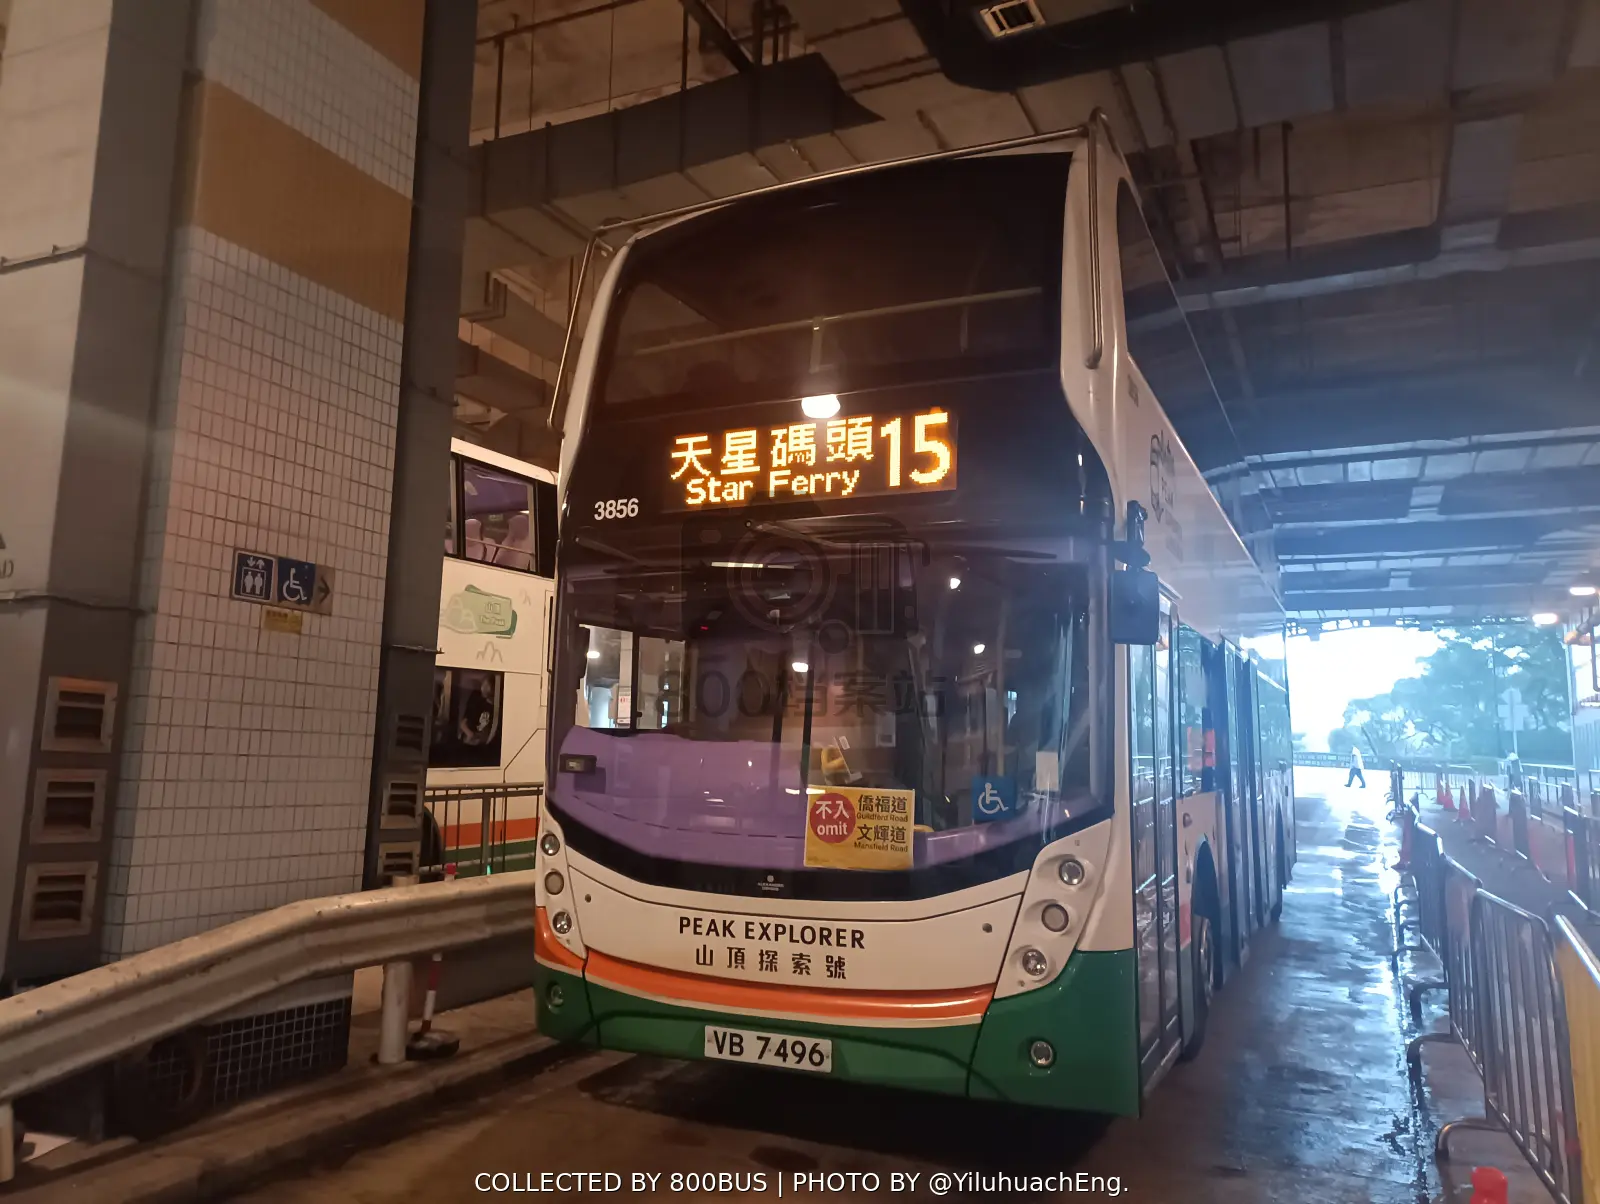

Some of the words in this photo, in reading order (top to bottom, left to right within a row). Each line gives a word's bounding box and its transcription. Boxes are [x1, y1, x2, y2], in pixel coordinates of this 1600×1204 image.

[670, 416, 875, 480] 天星碼頭
[880, 411, 951, 487] 15
[685, 477, 754, 505] Star
[768, 469, 861, 498] Ferry
[594, 497, 639, 521] 3856
[815, 800, 850, 820] 不入
[857, 794, 908, 814] 僑福道
[816, 821, 848, 836] omit
[889, 814, 909, 823] Road
[856, 823, 907, 844] 文輝道
[854, 841, 889, 852] Mansfield
[890, 844, 909, 853] Road
[679, 916, 737, 939] PEAK
[744, 921, 866, 950] EXPLORER
[695, 944, 847, 980] 山頂探索號
[713, 1030, 745, 1057] VB
[755, 1034, 825, 1067] 7496
